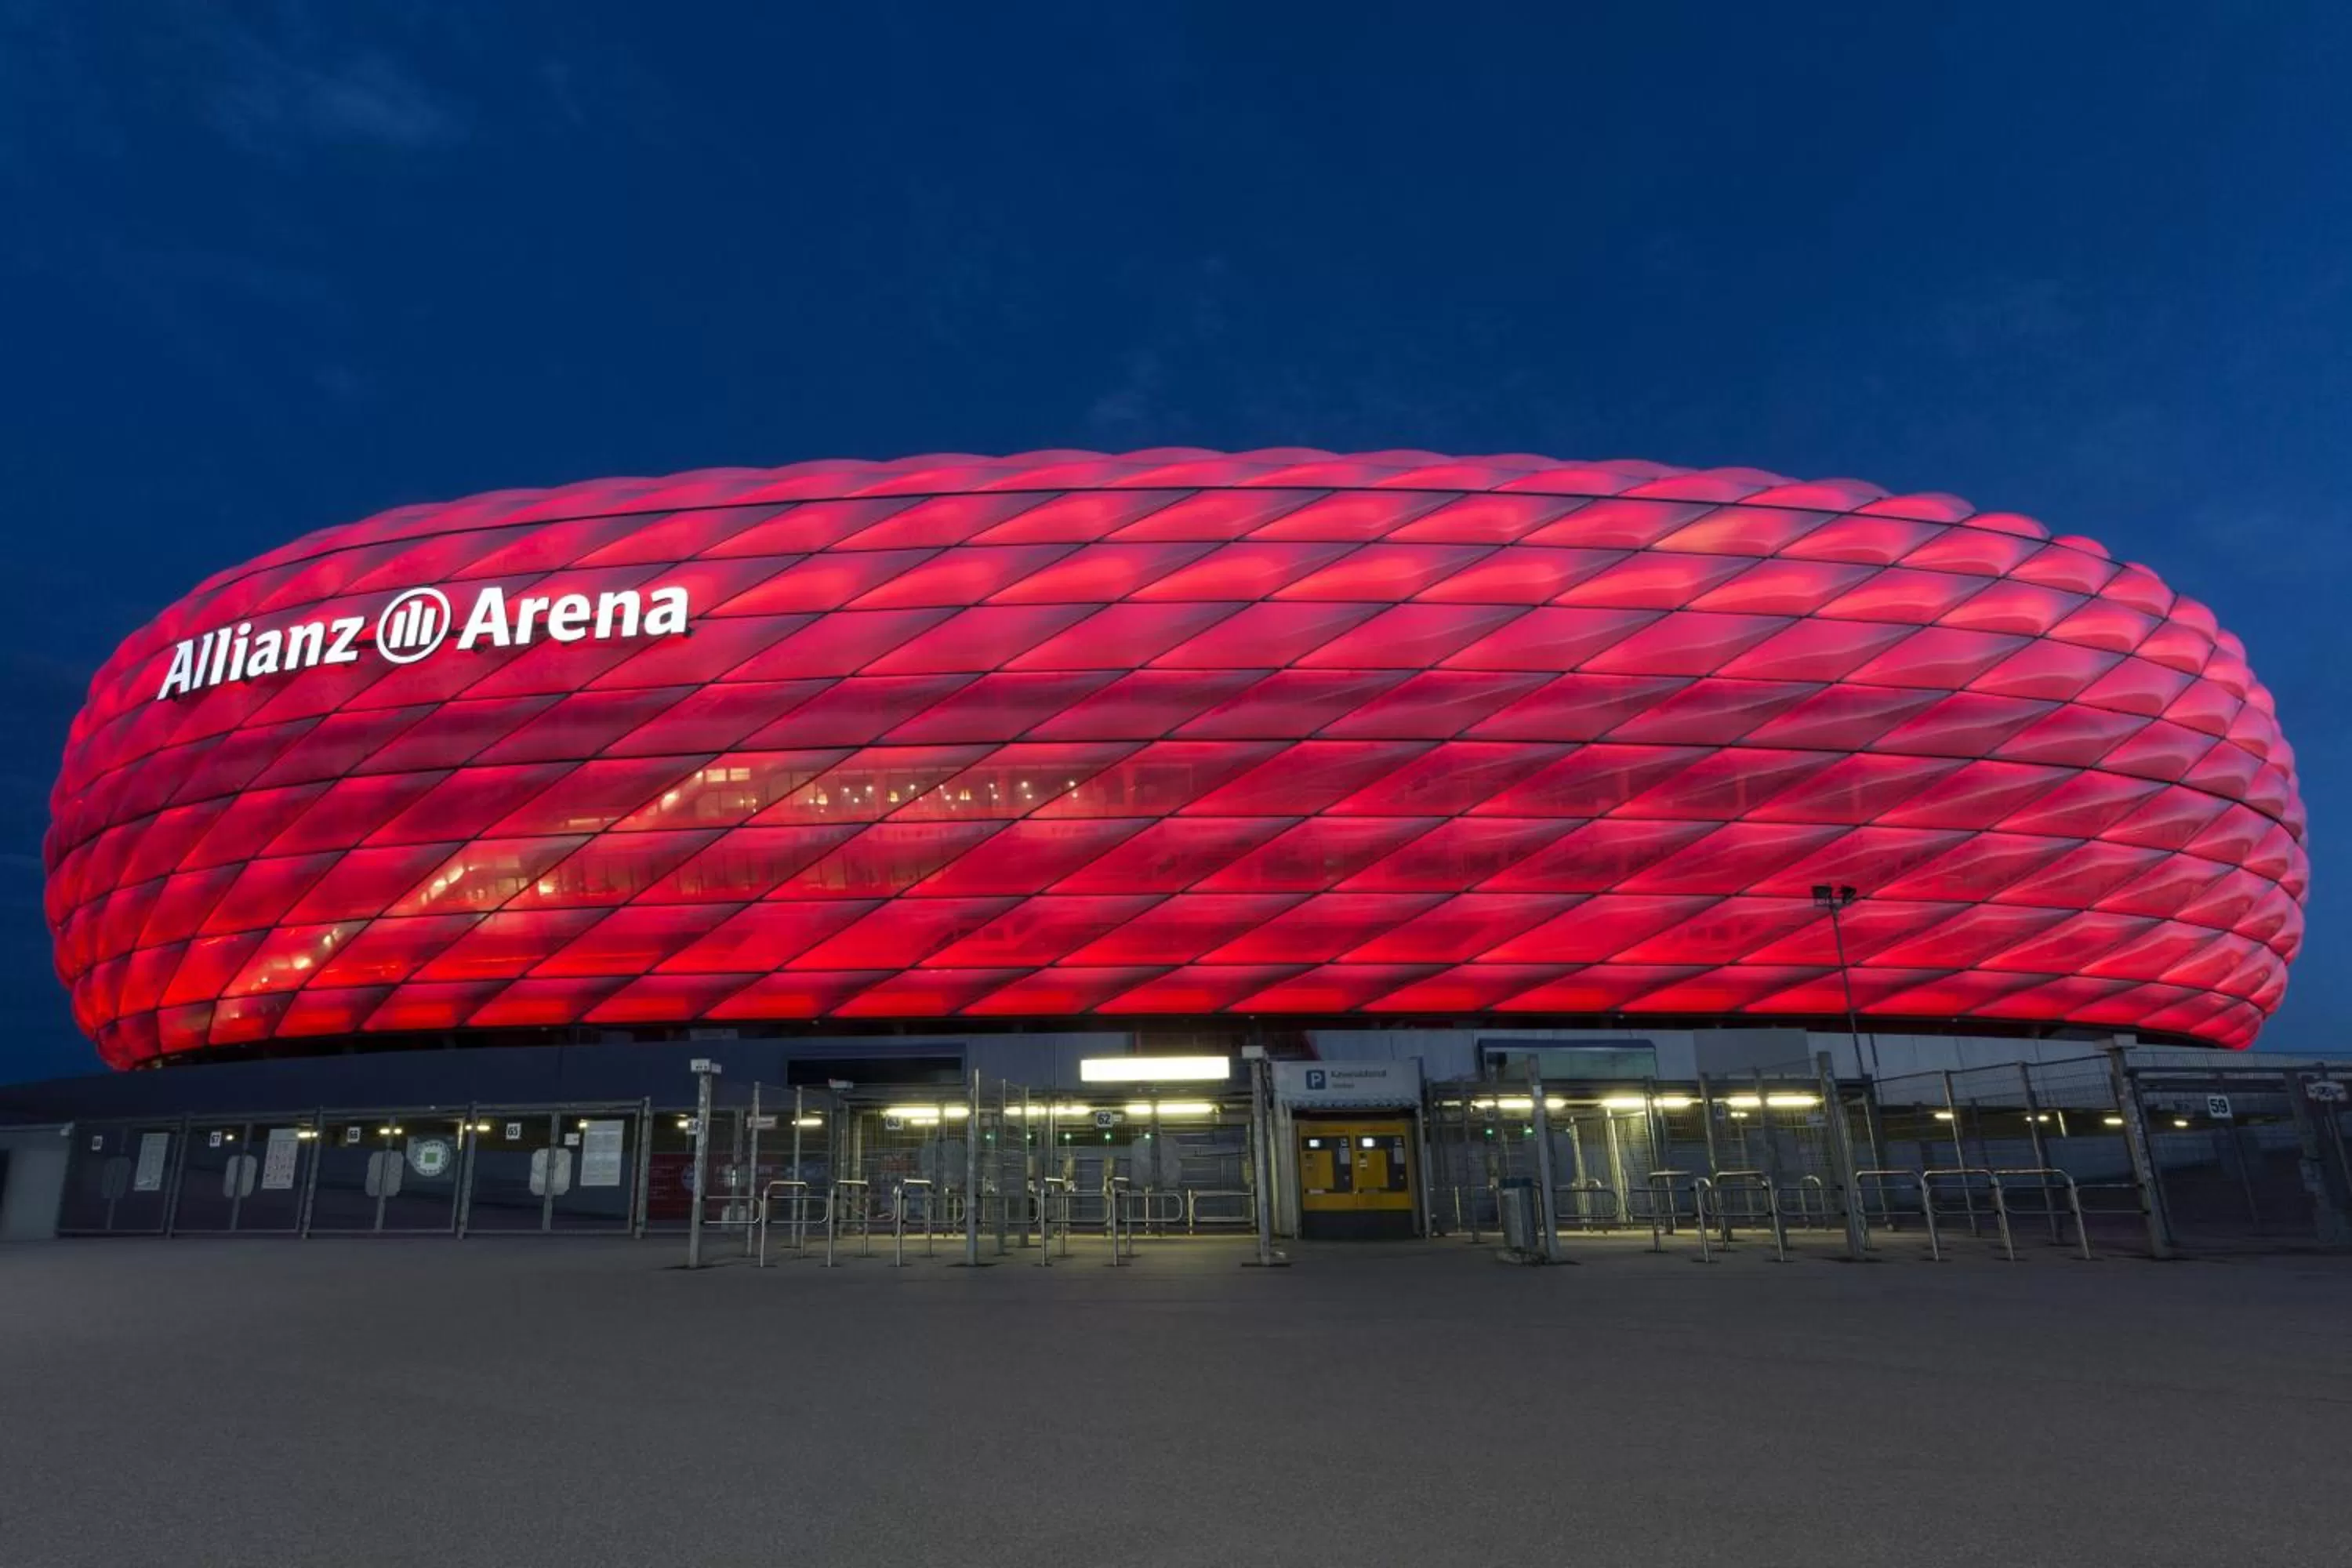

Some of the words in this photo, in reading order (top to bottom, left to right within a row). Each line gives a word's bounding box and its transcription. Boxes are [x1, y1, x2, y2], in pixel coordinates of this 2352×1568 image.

[158, 616, 365, 700] Allianz
[457, 586, 688, 650] Arena
[1311, 1073, 1322, 1087] P
[2210, 1098, 2228, 1114] 59
[1097, 1113, 1111, 1125] 62
